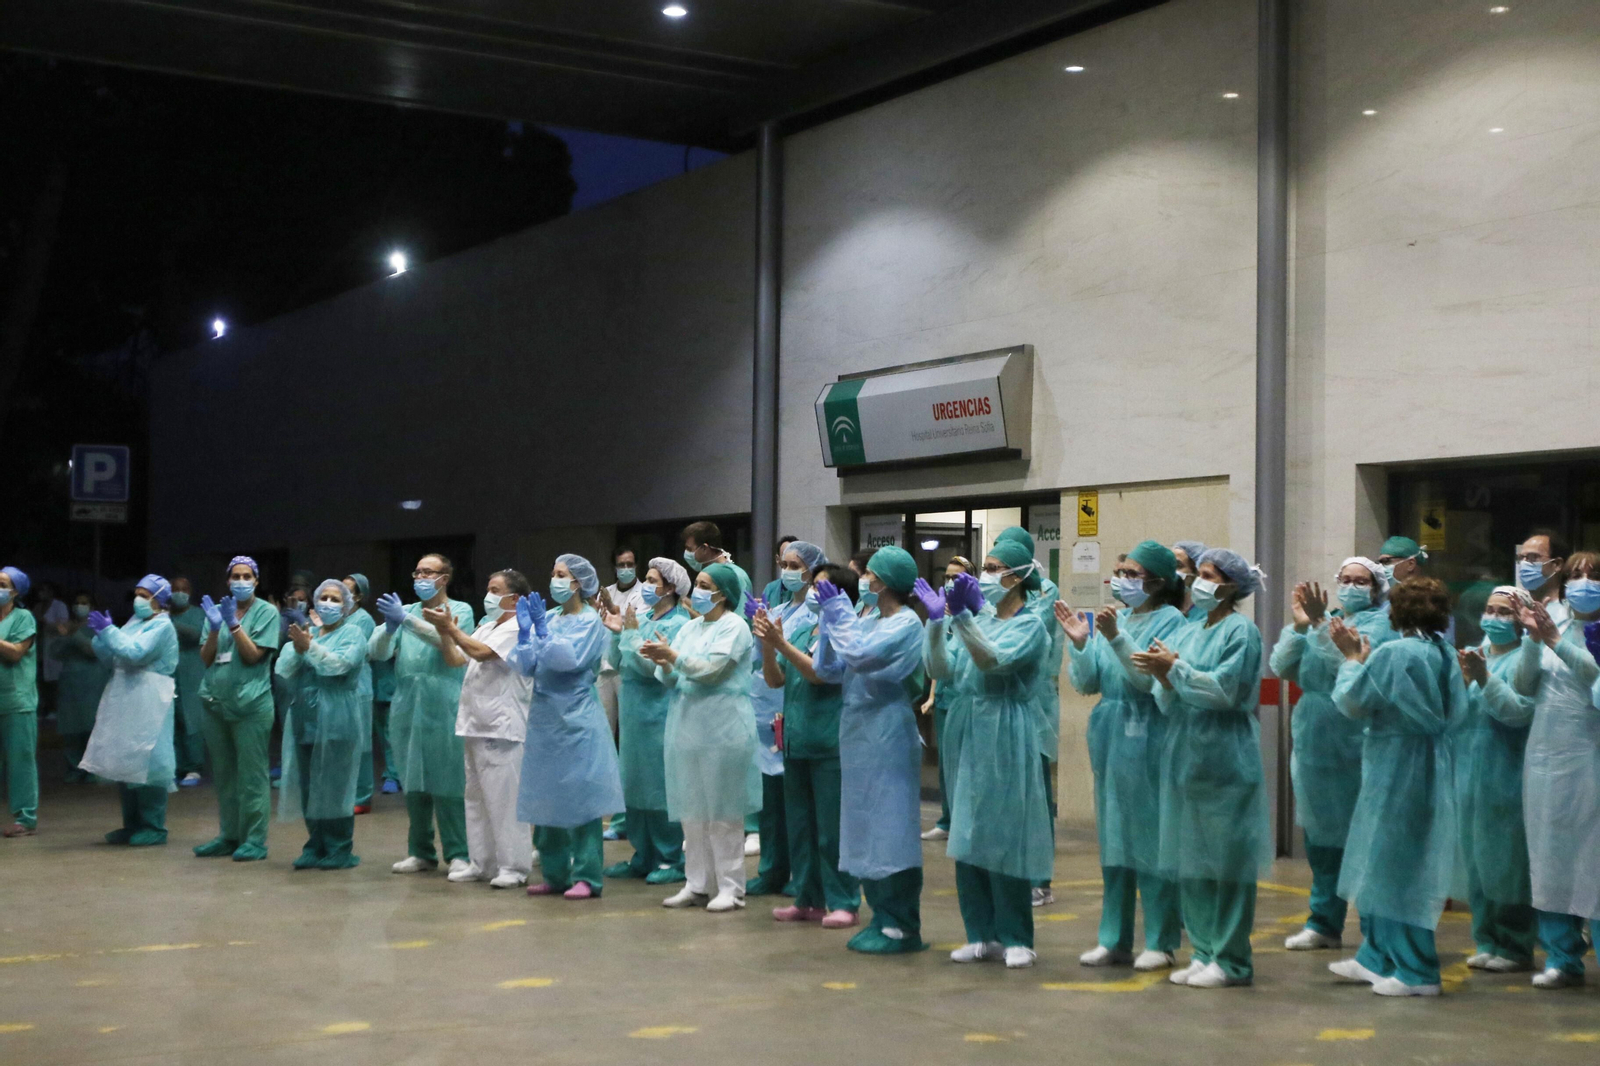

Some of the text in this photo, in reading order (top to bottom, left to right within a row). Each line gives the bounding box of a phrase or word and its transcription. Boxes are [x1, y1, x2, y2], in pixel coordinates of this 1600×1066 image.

[932, 396, 991, 421] URGENCIAS
[83, 452, 116, 493] P
[867, 533, 895, 548] Acceso
[1037, 524, 1060, 541] Acce
